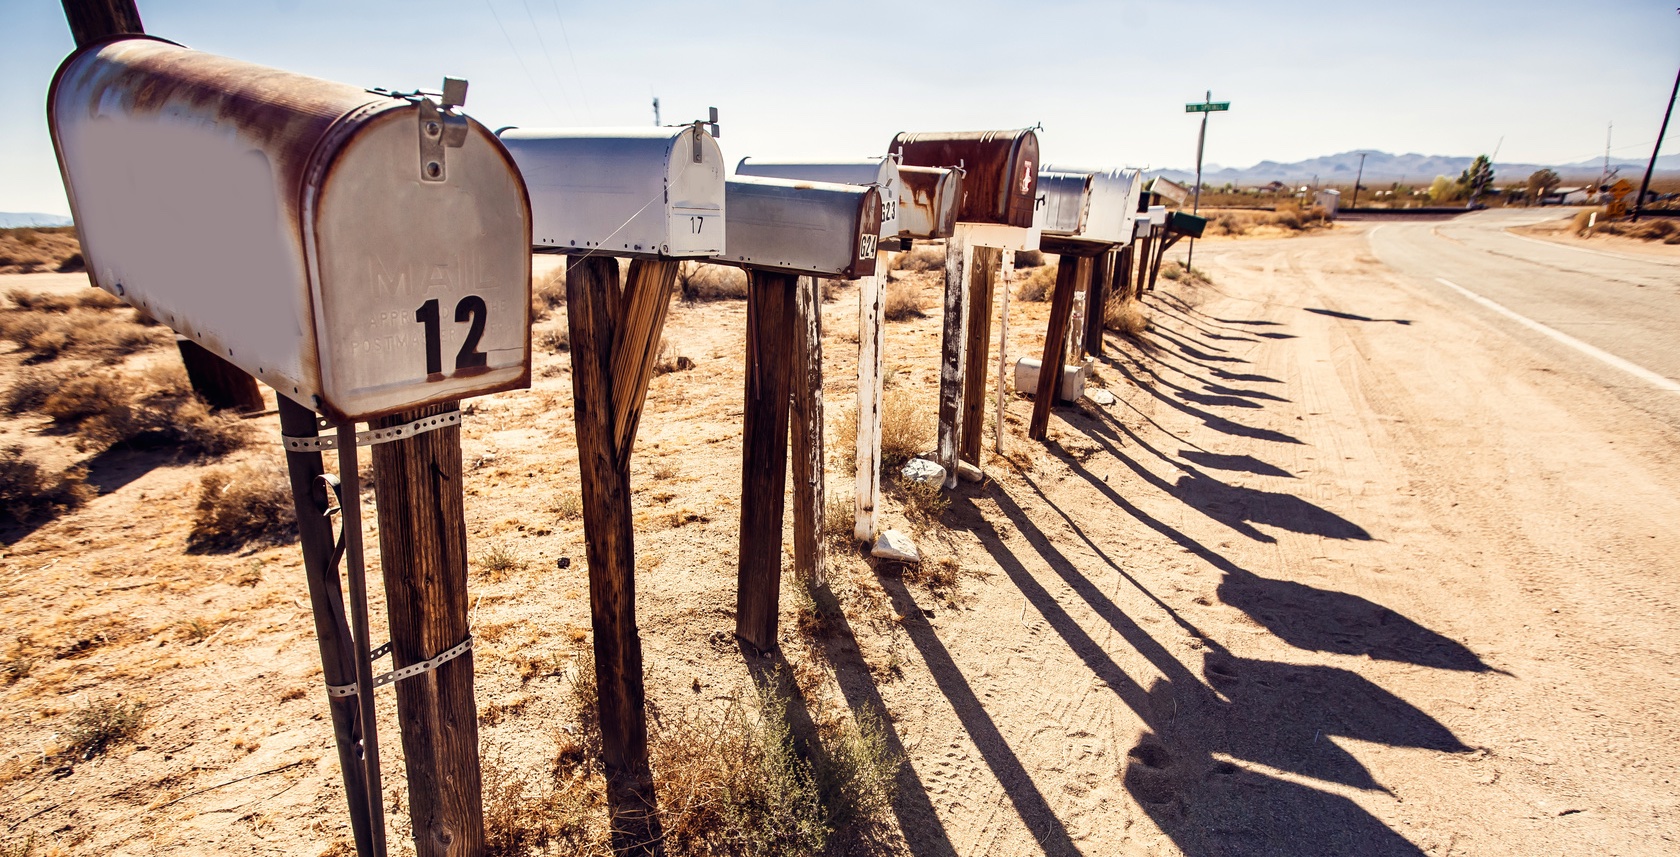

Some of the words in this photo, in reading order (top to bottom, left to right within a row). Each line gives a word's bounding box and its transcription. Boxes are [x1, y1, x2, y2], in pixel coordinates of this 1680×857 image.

[690, 216, 704, 234] 17
[860, 235, 877, 258] G24
[367, 250, 502, 298] MAIL
[415, 295, 488, 375] 12
